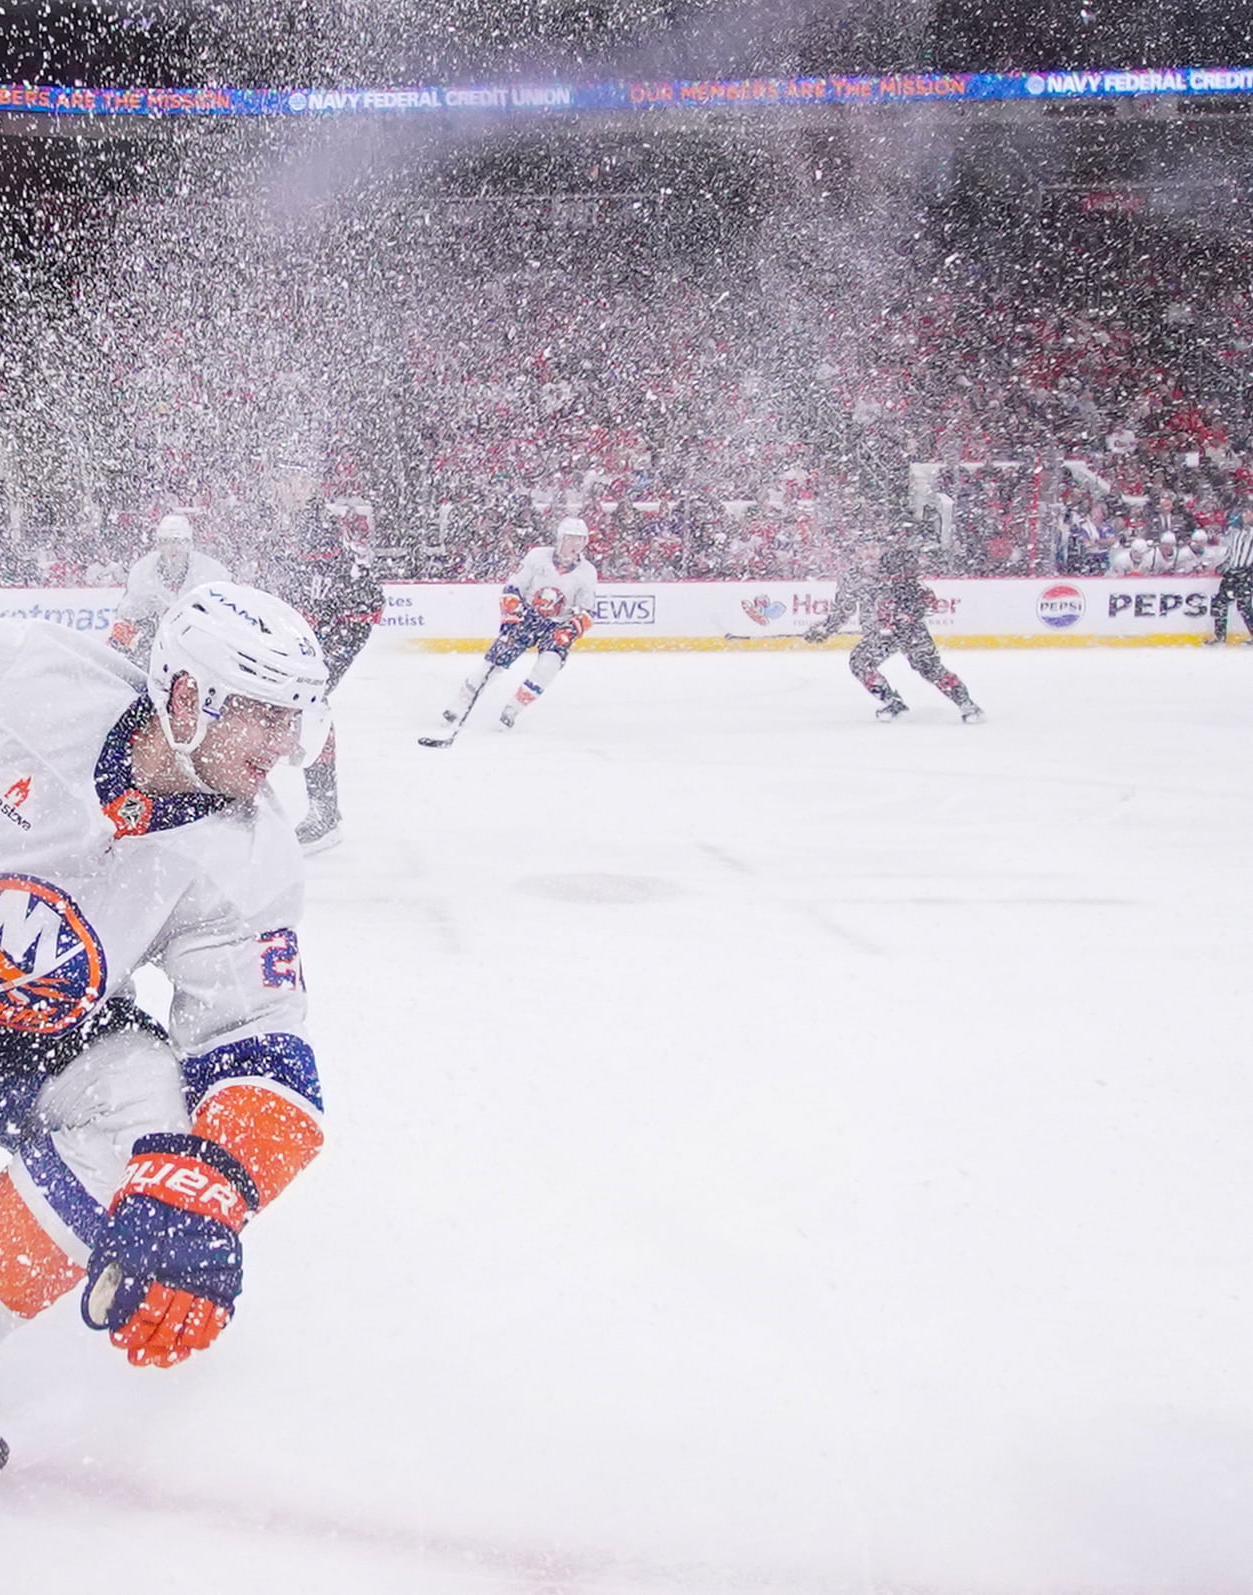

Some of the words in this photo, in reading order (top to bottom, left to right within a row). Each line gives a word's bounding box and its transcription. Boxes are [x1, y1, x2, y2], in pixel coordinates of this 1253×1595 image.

[631, 83, 673, 102] OUR
[680, 81, 779, 101] MEMBERS
[786, 80, 826, 99] ARE
[832, 80, 872, 98] THE
[879, 78, 966, 96] MISSION
[1048, 75, 1101, 93] NAVY
[1104, 73, 1187, 92] FEDERAL
[56, 92, 95, 109] ARE
[103, 90, 141, 109] THE
[146, 90, 231, 110] MISSION
[308, 93, 361, 111] NAVY
[363, 90, 442, 109] FEDERAL
[445, 89, 508, 107] CREDIT
[387, 596, 414, 607] tes
[596, 600, 652, 620] EWS
[1039, 602, 1083, 612] PEPSI
[379, 614, 425, 627] entist
